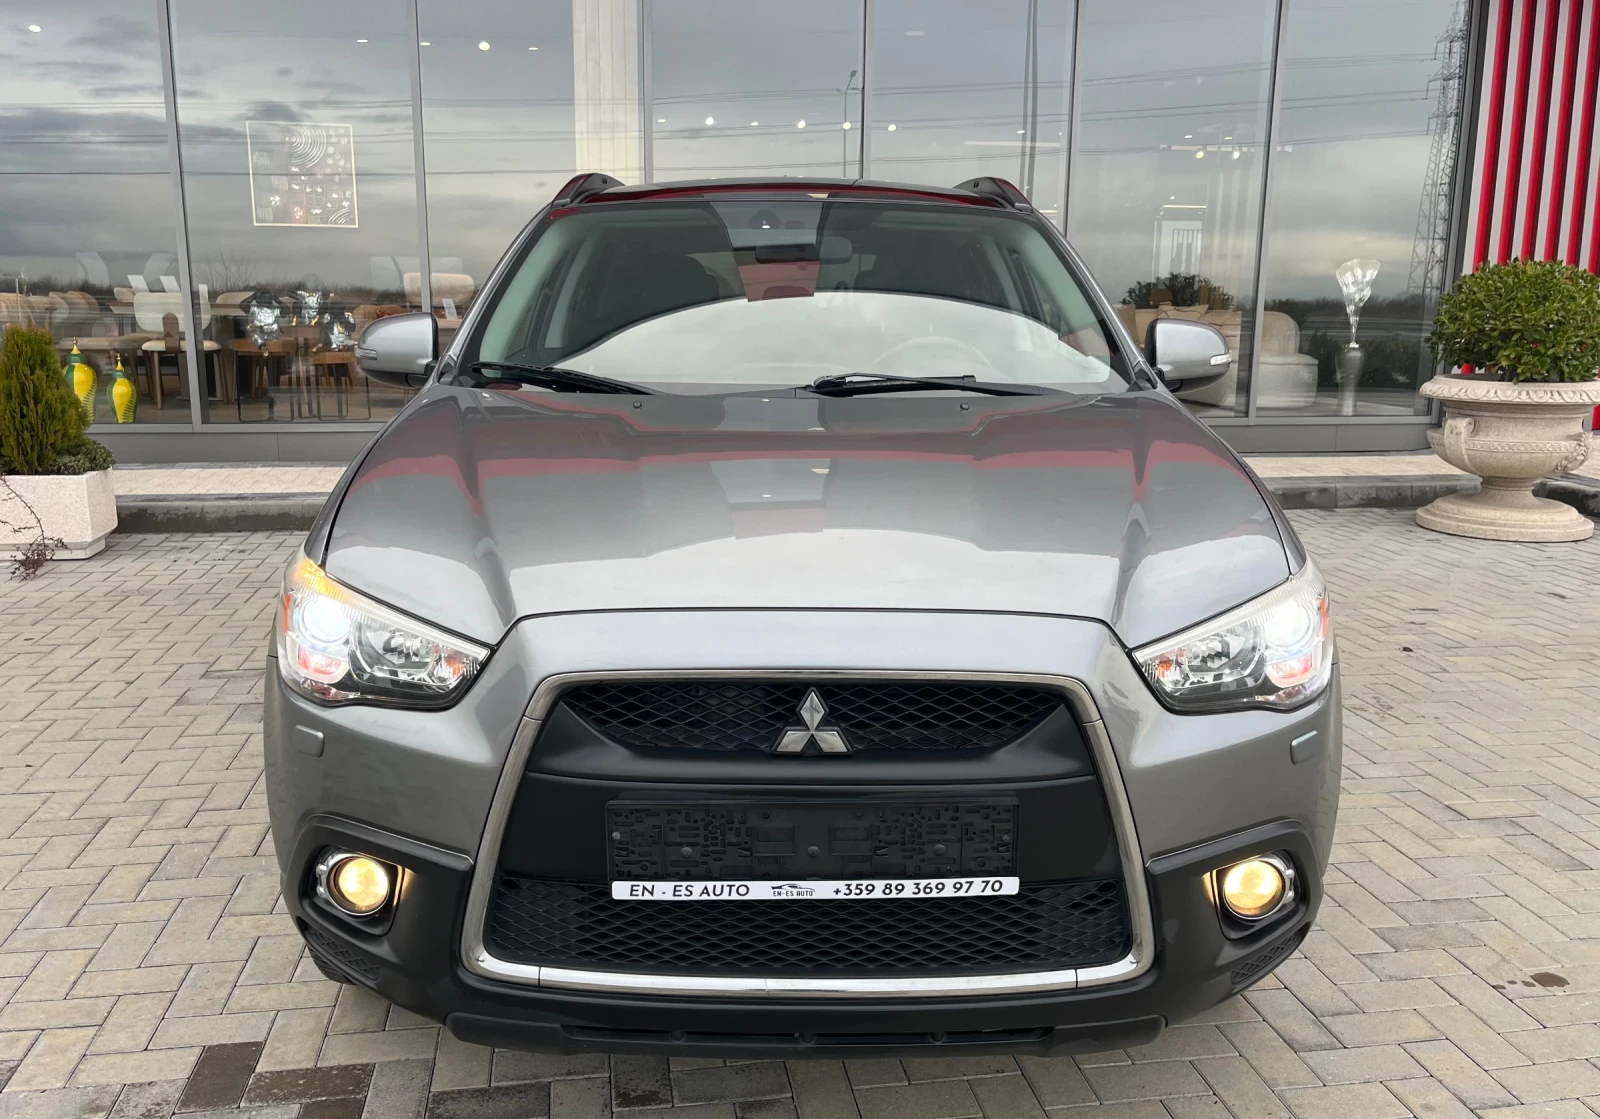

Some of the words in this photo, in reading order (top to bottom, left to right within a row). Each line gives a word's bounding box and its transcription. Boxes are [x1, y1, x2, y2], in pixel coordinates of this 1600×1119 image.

[629, 884, 655, 897] EN
[673, 884, 694, 898] ES
[698, 883, 750, 897] AUTO
[833, 883, 876, 897] +359
[881, 882, 906, 896] 89
[911, 881, 946, 896] 369
[952, 881, 975, 894] 97
[980, 879, 1003, 893] 70
